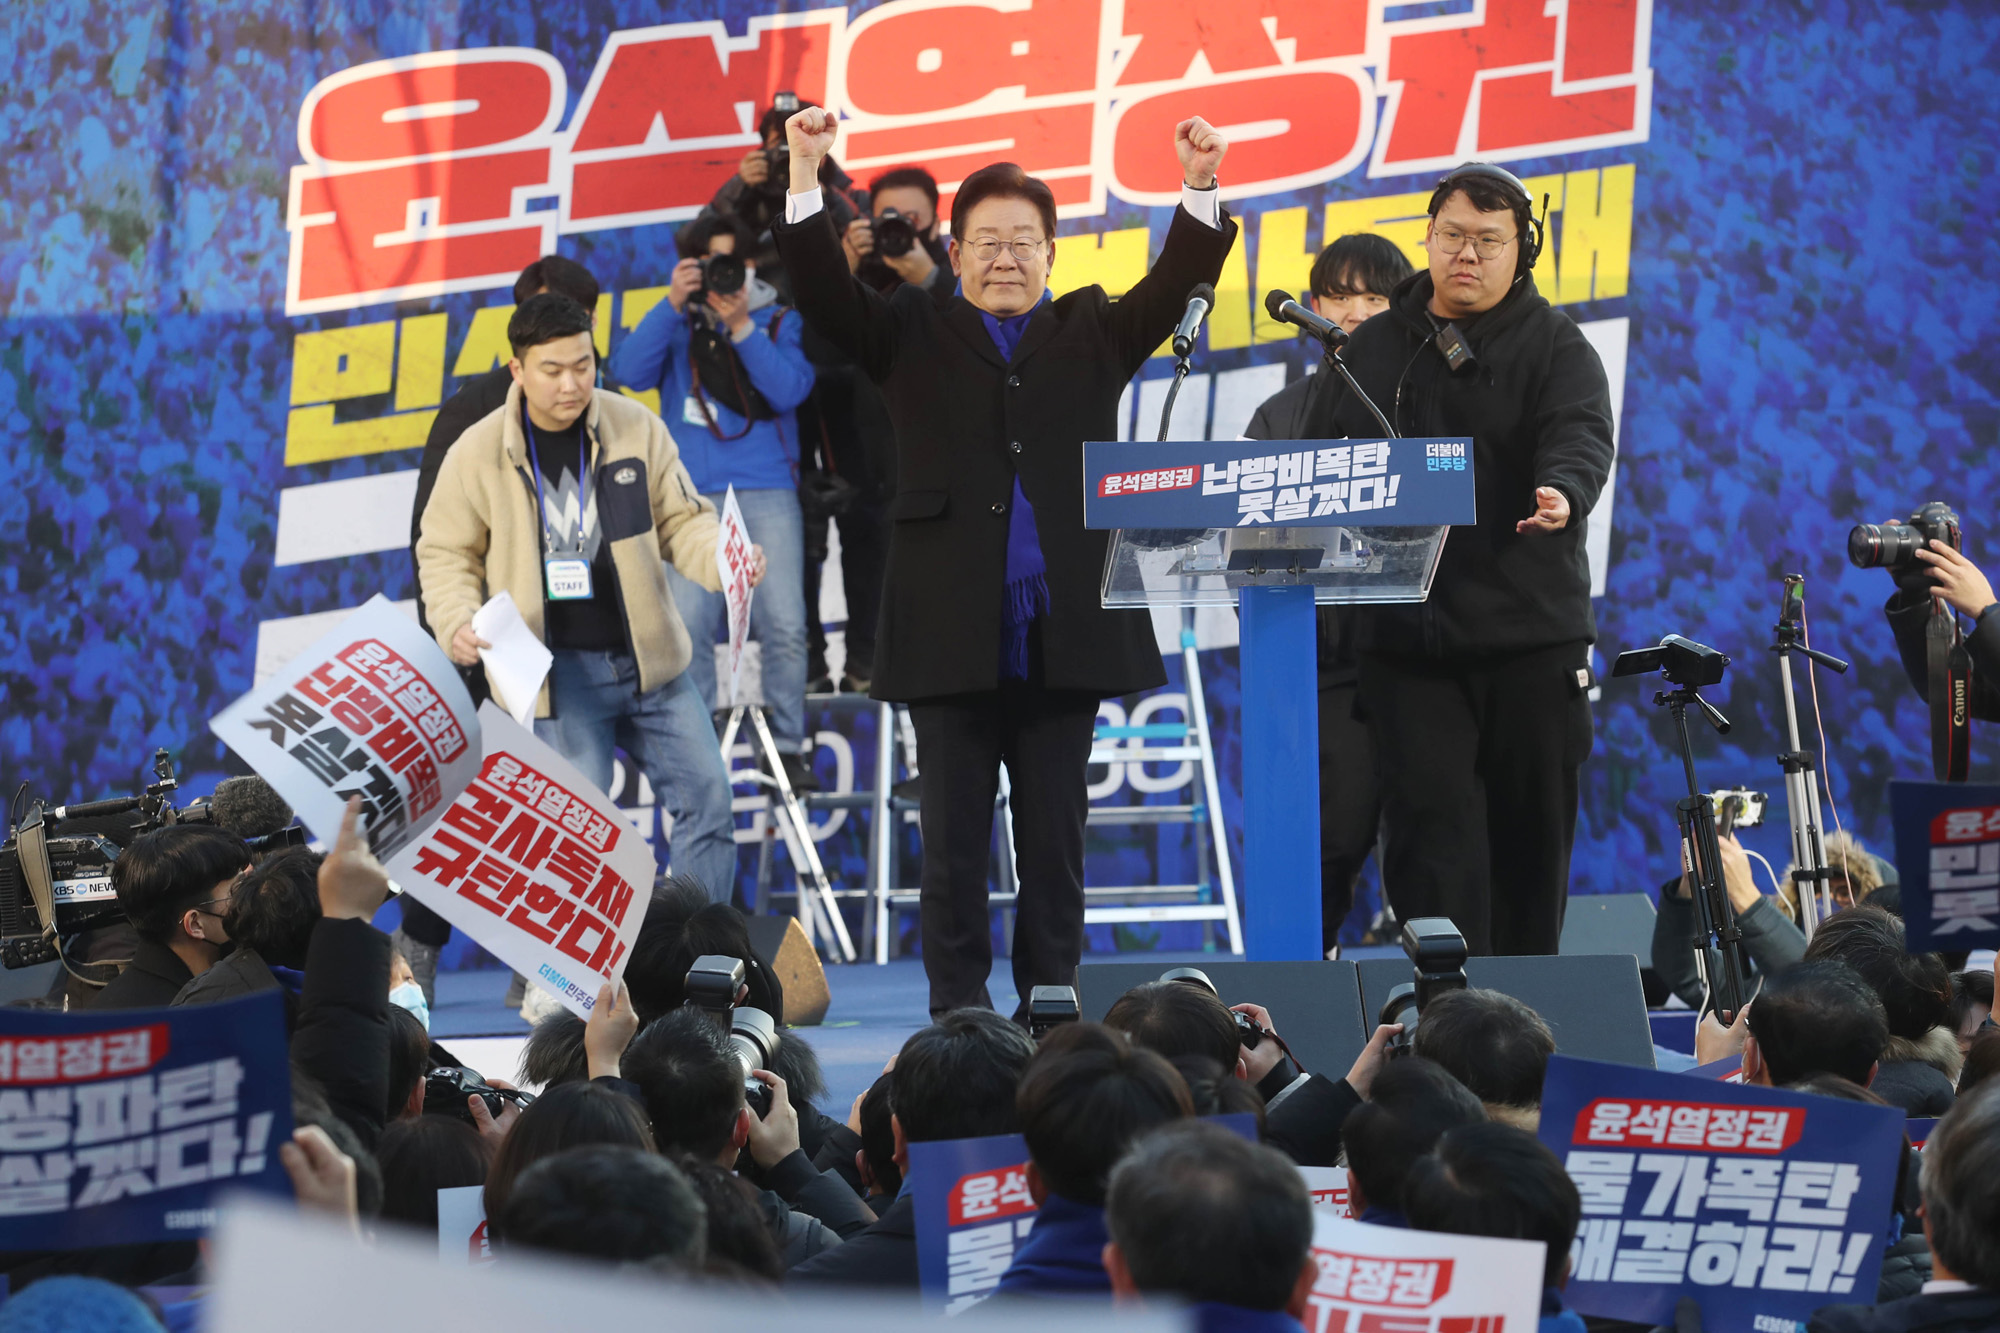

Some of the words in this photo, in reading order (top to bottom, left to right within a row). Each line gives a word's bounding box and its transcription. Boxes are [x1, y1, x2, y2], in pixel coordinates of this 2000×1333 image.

[1202, 441, 1391, 496] 난방비폭탄
[1426, 443, 1464, 457] 더불어
[1427, 457, 1467, 472] 민주당
[1104, 467, 1194, 495] 윤석열정권
[1236, 474, 1401, 527] 못살겠다!
[554, 581, 583, 591] STAFF
[346, 642, 467, 762] 윤석열정권
[1953, 679, 1965, 727] Canon
[486, 756, 614, 850] 윤석열정권
[448, 782, 635, 929] 검사독재
[89, 882, 116, 893] NEW
[412, 828, 627, 981] 규탄한다!
[1587, 1102, 1790, 1150] 윤석열정권
[1564, 1151, 1863, 1227] 물가폭탄
